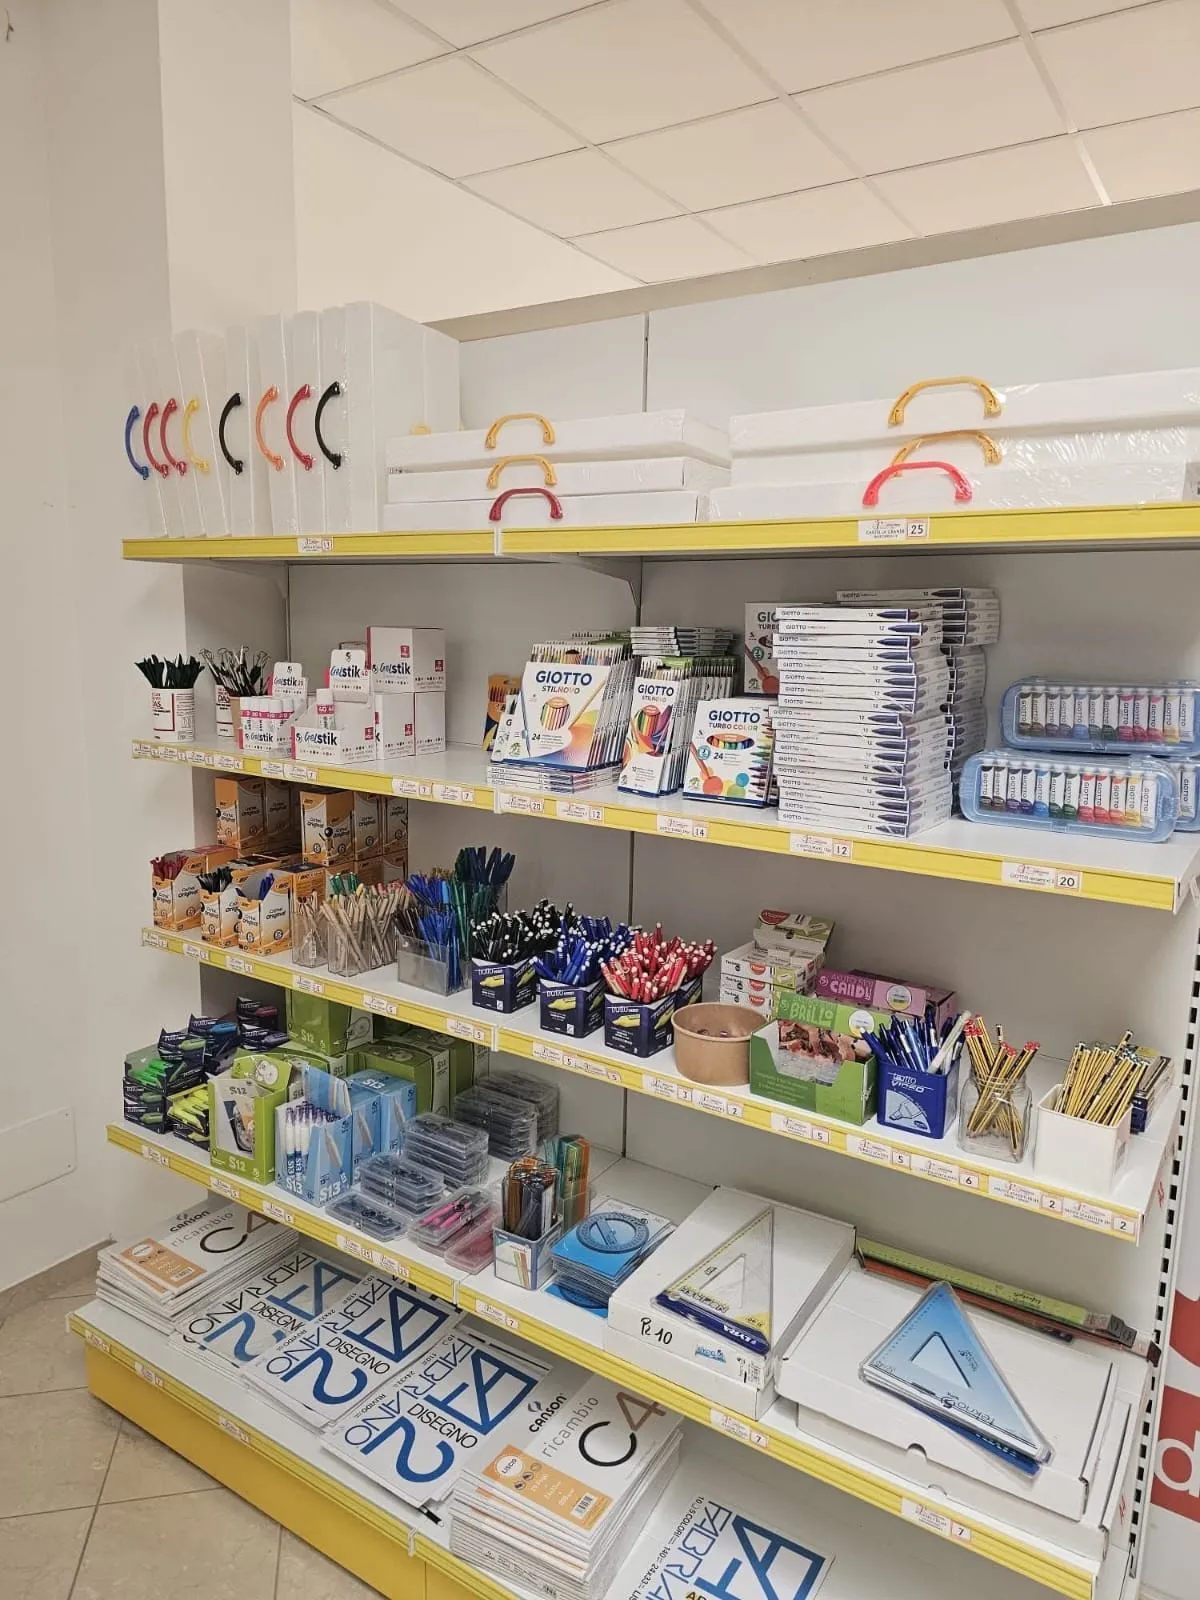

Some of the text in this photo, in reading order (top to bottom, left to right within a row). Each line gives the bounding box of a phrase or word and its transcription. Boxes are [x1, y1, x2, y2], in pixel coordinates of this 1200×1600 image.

[911, 524, 924, 535] 25
[536, 670, 592, 686] GIOTTO
[638, 684, 674, 696] GIOTTO
[709, 710, 760, 723] GIOTTO
[1060, 877, 1074, 886] 20
[830, 981, 872, 1000] CANDY
[229, 1086, 247, 1095] S12
[228, 1157, 246, 1170] S12
[898, 1155, 904, 1164] 5
[966, 1177, 972, 1186] 6
[1049, 1200, 1055, 1208] 2
[170, 1210, 210, 1232] canson
[171, 1211, 234, 1247] ricambio
[1120, 1221, 1127, 1230] 2
[189, 1253, 317, 1336] FABRIANO
[266, 1278, 392, 1375] FABRIANO
[654, 1328, 672, 1345] 10
[327, 1336, 390, 1375] DISEGNO
[280, 1347, 368, 1405] 2
[344, 1338, 474, 1446] FABRIANO
[529, 1396, 566, 1433] canson
[407, 1402, 478, 1448] DISEGNO
[541, 1396, 598, 1458] ricambio
[578, 1391, 667, 1467] C4
[360, 1416, 455, 1483] 2
[660, 1546, 671, 1559] 140
[641, 1563, 659, 1585] 24x33
